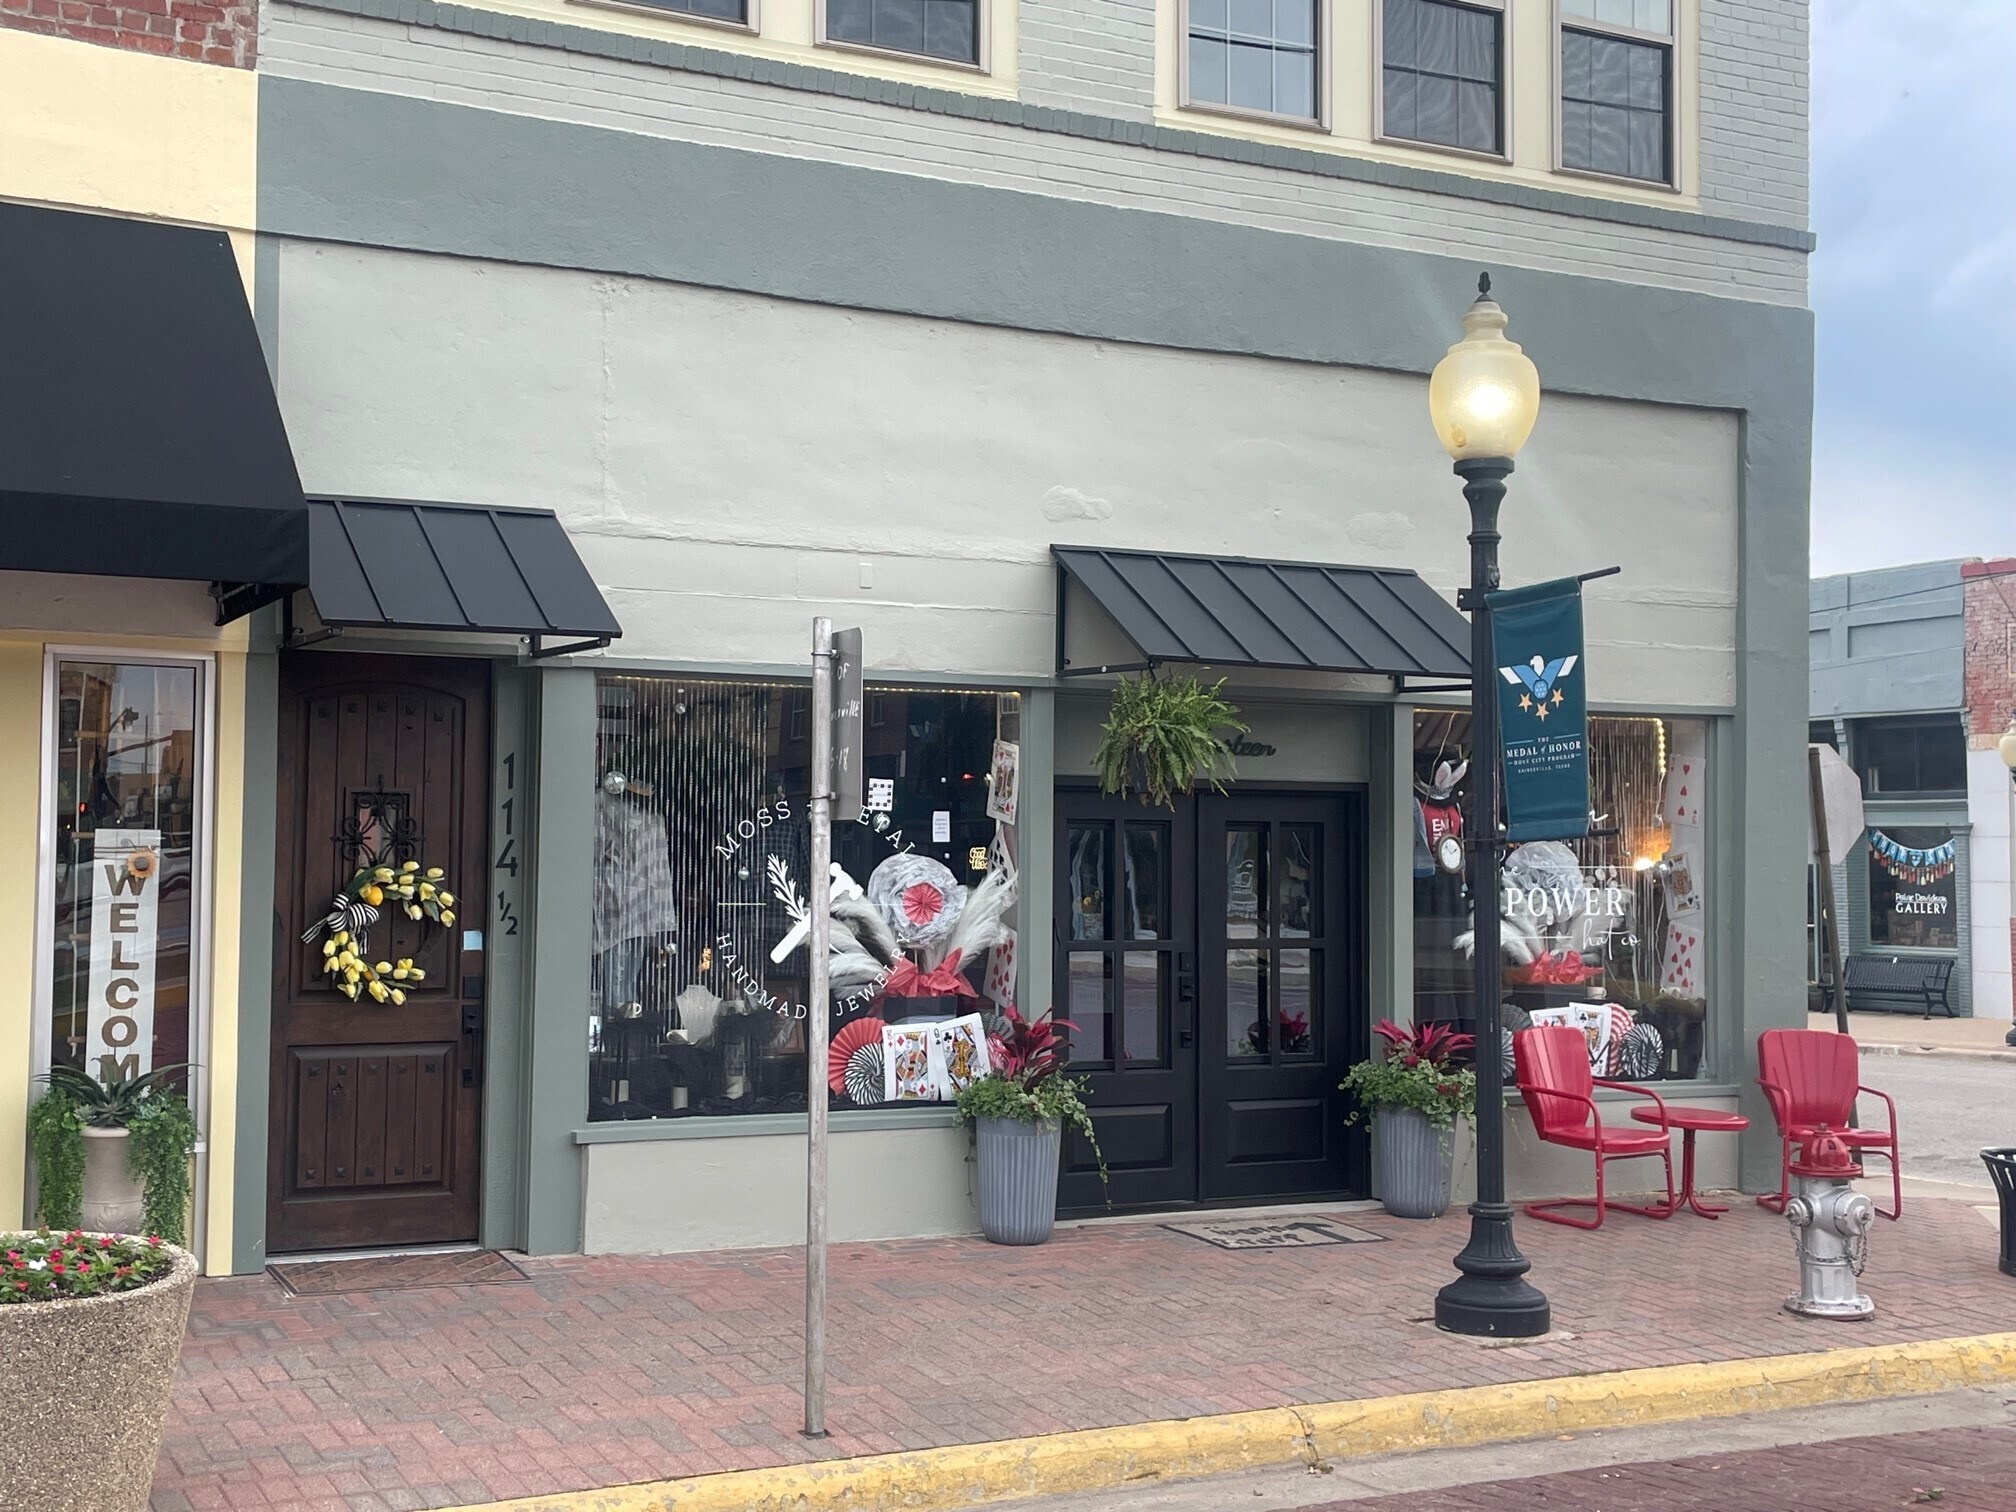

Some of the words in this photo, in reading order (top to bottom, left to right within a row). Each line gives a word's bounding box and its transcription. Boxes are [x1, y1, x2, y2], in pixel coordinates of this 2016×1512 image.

[1506, 746, 1538, 758] MEDAL
[1548, 740, 1582, 753] HONOR
[1547, 753, 1576, 761] PROGRAM
[496, 753, 518, 877] 114
[715, 800, 791, 860] MOSS
[1504, 887, 1625, 917] POWER
[1895, 902, 1948, 914] GALLERY
[101, 864, 147, 1084] WELCOM
[716, 933, 807, 1019] HANDMAD
[835, 932, 910, 1017] JEWELRY
